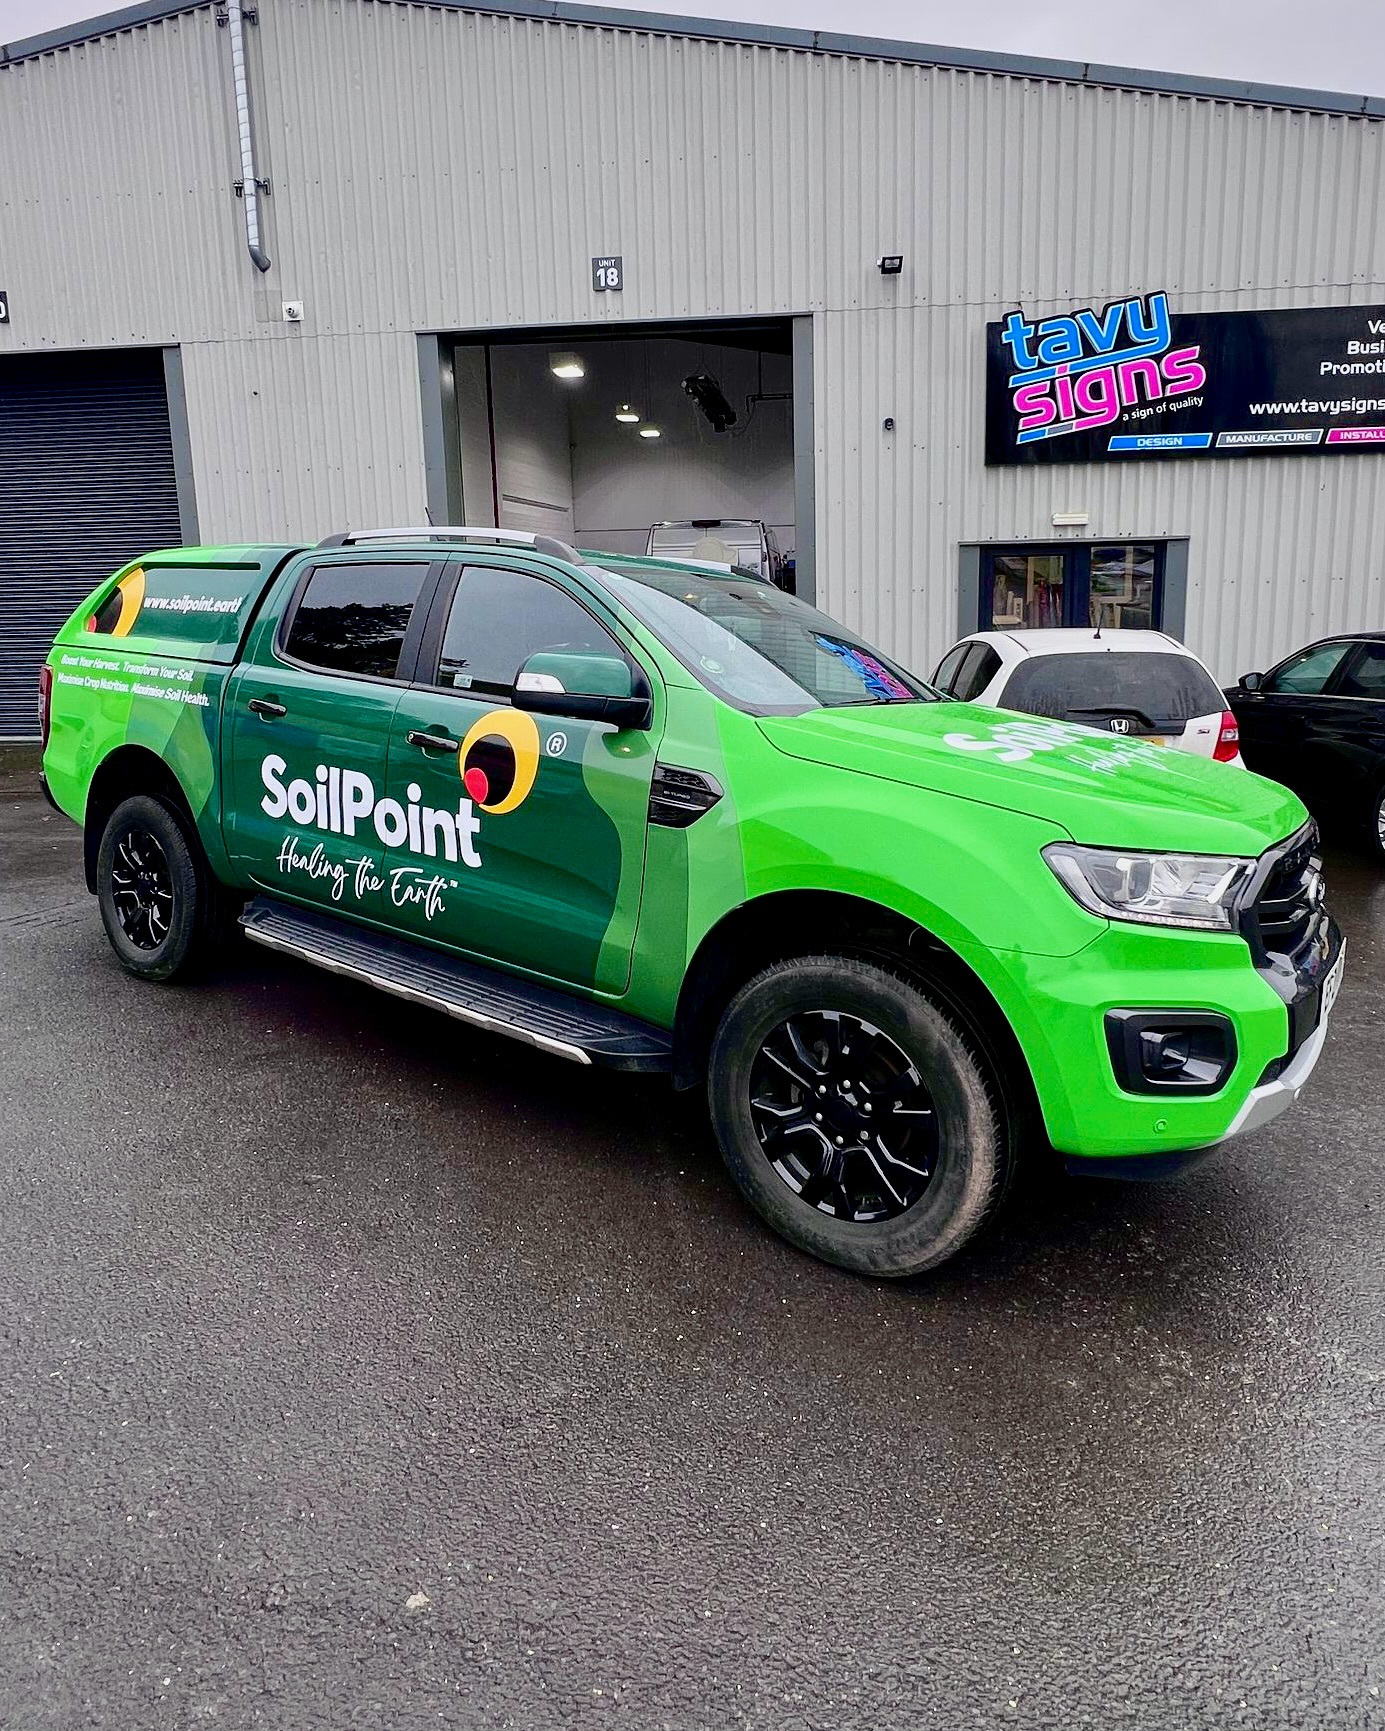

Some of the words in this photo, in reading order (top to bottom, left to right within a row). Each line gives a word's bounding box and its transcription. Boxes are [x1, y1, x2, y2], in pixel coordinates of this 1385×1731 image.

[598, 259, 616, 267] UNIT
[596, 267, 619, 287] 18
[1001, 292, 1172, 371] tavy
[1347, 339, 1385, 355] Busi
[1012, 345, 1207, 433] signs
[1122, 412, 1130, 422] a
[1131, 404, 1154, 420] sign
[1155, 401, 1168, 414] of
[1168, 395, 1204, 413] quality
[1249, 397, 1385, 415] www.tavysigns
[1136, 436, 1184, 447] DESIGN
[1225, 433, 1313, 444] MANUFACTURE
[79, 655, 95, 668] Your
[122, 660, 160, 676] Transform
[159, 665, 177, 680] Your
[84, 675, 101, 690] Crop
[130, 682, 165, 699] Maximise
[164, 687, 182, 701] Soil
[260, 753, 483, 868] SoilPoint
[276, 836, 349, 900] Healing
[345, 856, 385, 899] the
